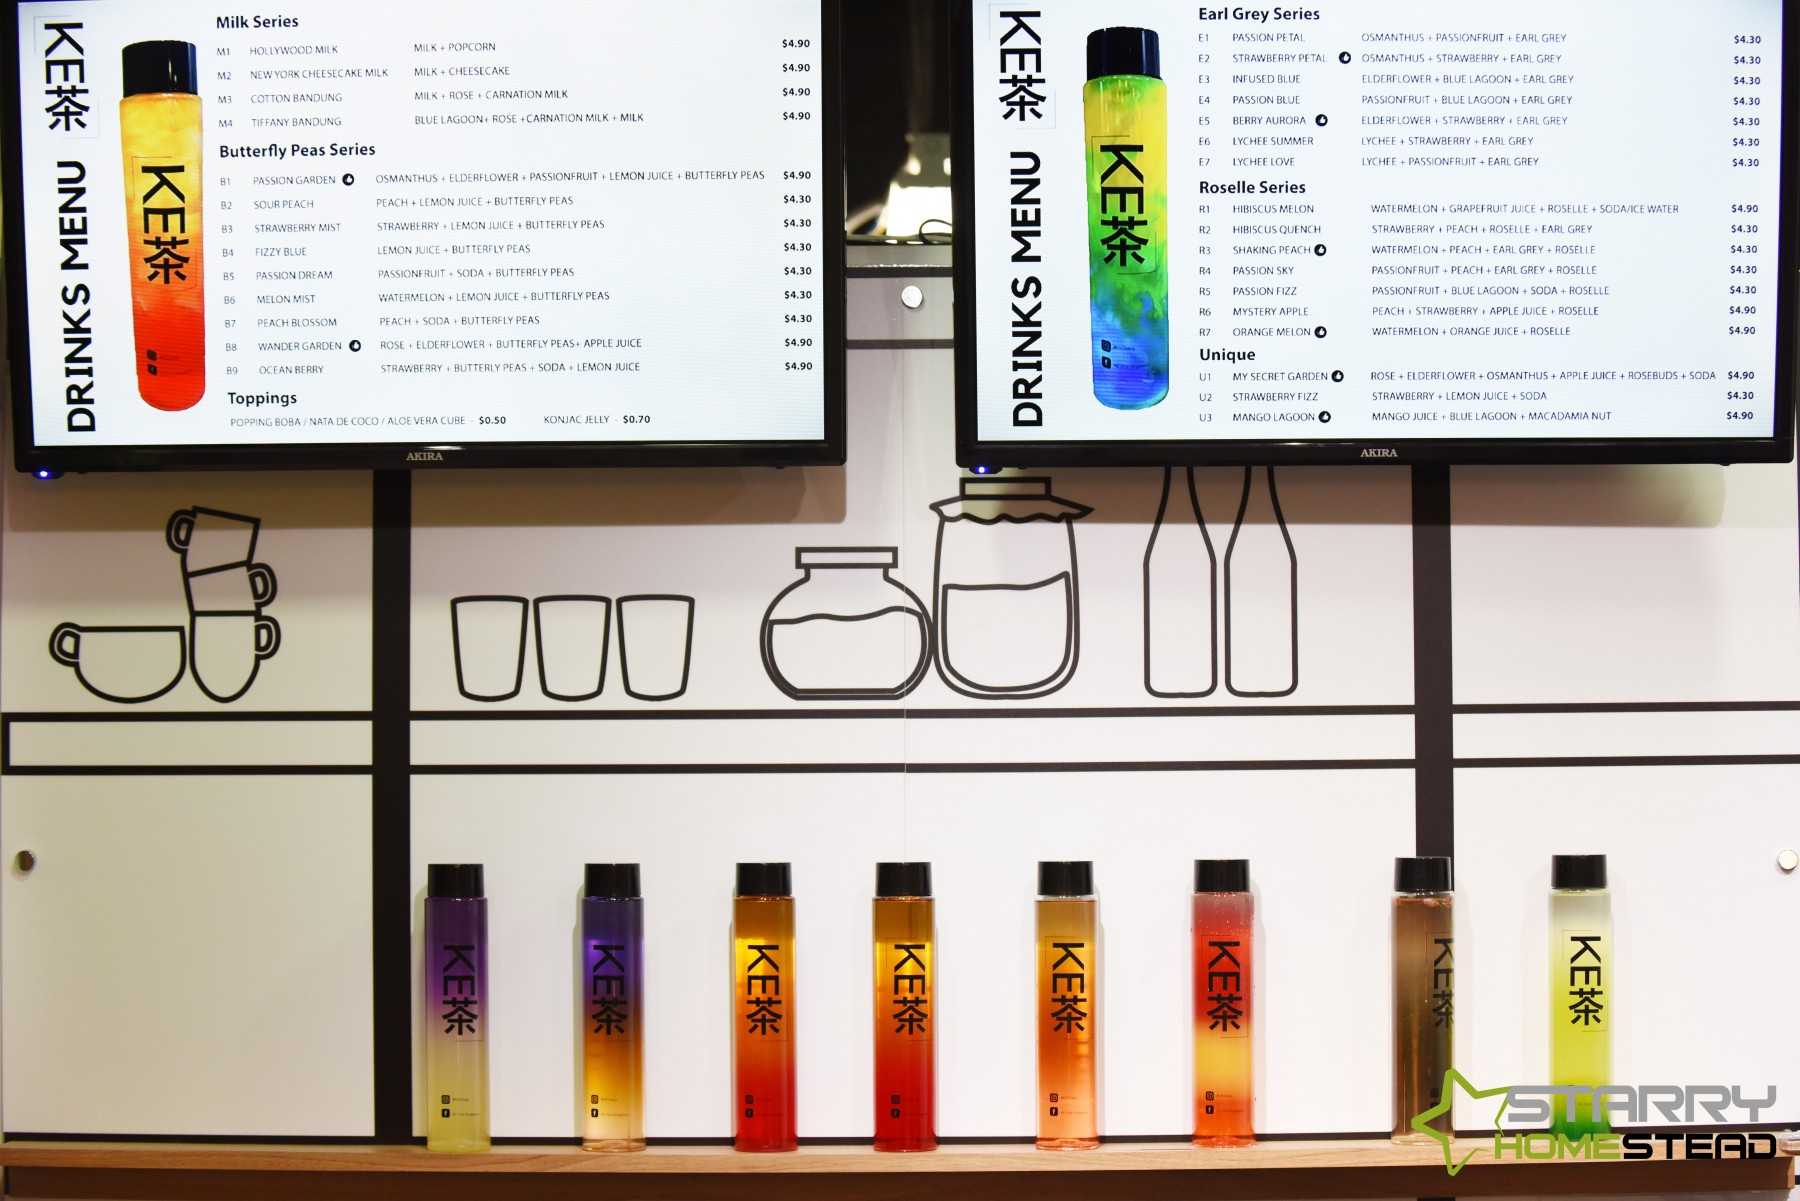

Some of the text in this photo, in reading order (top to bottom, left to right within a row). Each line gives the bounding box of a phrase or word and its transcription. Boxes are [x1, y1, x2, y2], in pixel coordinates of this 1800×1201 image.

[1198, 7, 1320, 23] Earl Grey Series
[216, 14, 298, 28] Milk Series
[1232, 32, 1302, 42] PASSION PETAL
[1361, 32, 1424, 42] OSMANTHUS
[1734, 35, 1761, 44] $4.30
[448, 42, 495, 51] POPCORN
[782, 39, 810, 48] $4.90
[249, 45, 338, 55] HOLLYWOOD MILK
[1232, 53, 1324, 62] STRAWBERRY PETAL
[1733, 55, 1761, 64] $4.30
[782, 63, 810, 72] $4.90
[999, 11, 1047, 121] KE茶
[250, 68, 388, 79] NEW YORK CHEESECAKE MILK
[448, 66, 509, 76] CHEESECAKE
[44, 22, 90, 131] KE茶
[1232, 74, 1300, 83] INFUSED BLUE
[1469, 74, 1511, 83] LAGOON
[1733, 76, 1760, 85] $4.30
[782, 87, 810, 96] $4.90
[250, 93, 342, 103] COTTON BANDUNG
[1232, 95, 1300, 104] PASSION BLUE
[1733, 96, 1760, 105] $4.30
[782, 111, 810, 120] $4.90
[1442, 115, 1505, 125] STRAWBERRY
[251, 117, 341, 127] TIFFANY BANDUNG
[1232, 116, 1306, 125] BERRY AURORA
[1732, 117, 1760, 126] $4.30
[1232, 136, 1313, 145] LYCHEE SUMMER
[1732, 137, 1759, 146] $4.30
[219, 142, 375, 159] Butterfly Peas Series
[1232, 157, 1294, 166] LYCHEE LOVE
[1732, 158, 1759, 167] $4.30
[449, 172, 518, 182] ELDERFLOWER
[783, 170, 811, 180] $4.90
[253, 175, 335, 185] PASSION GARDEN
[1199, 181, 1306, 194] Roselle Series
[783, 194, 811, 204] $4.30
[253, 199, 313, 209] SOUR PEACH
[1100, 144, 1149, 267] KE茶
[1232, 204, 1314, 213] HIBISCUS MELON
[1448, 204, 1507, 213] GRAPEFRUIT
[1731, 204, 1758, 212] $4.90
[141, 165, 190, 284] KE茶
[783, 218, 811, 227] $4.30
[254, 223, 339, 232] STRAWBERRY MIST
[1232, 225, 1321, 234] HIBISCUS QUENCH
[1731, 224, 1758, 233] $4.30
[783, 242, 811, 251] $4.30
[1232, 245, 1310, 254] SHAKING PEACH
[1730, 245, 1757, 253] $4.30
[255, 247, 306, 256] FIZZY BLUE
[378, 268, 445, 278] PASSIONFRUIT
[784, 266, 811, 275] $4.30
[1232, 266, 1294, 275] PASSION SKY
[1730, 265, 1757, 274] $4.30
[256, 270, 332, 280] PASSION DREAM
[1010, 151, 1043, 426] DRINKS MENU
[1232, 286, 1296, 296] PASSION FIZZ
[1729, 285, 1756, 294] $4.30
[57, 161, 96, 432] DRINKS MENU
[256, 294, 314, 304] MELON MIST
[378, 292, 444, 302] WATERMELON
[784, 290, 812, 299] $4.30
[1232, 307, 1308, 316] MYSTERY APPLE
[1729, 305, 1756, 314] $4.90
[257, 318, 336, 327] PEACH BLOSSOM
[784, 314, 812, 323] $4.30
[1232, 327, 1310, 336] ORANGE MELON
[1449, 326, 1490, 335] ORANGE
[1728, 326, 1755, 335] $4.90
[257, 341, 341, 351] WANDER GARDEN
[784, 338, 812, 346] $4.90
[1200, 348, 1255, 363] Unique
[258, 365, 323, 374] OCEAN BERRY
[453, 363, 500, 372] BUTTERLY
[784, 361, 812, 370] $4.90
[1232, 371, 1328, 381] MY SECRET GARDEN
[1627, 370, 1678, 380] ROSEBUDS
[1727, 371, 1754, 379] $4.90
[228, 392, 297, 407] Toppings
[1232, 392, 1318, 401] STRAWBERRY FIZZ
[1727, 391, 1754, 399] $4.30
[543, 415, 650, 424] KONJAC JELLY $0.70
[1232, 412, 1314, 422] MANGO LAGOON
[1528, 411, 1588, 420] MACADAMIA
[1726, 411, 1753, 420] $4.90
[230, 416, 506, 426] POPPING BOBA NATA DE COCO ALOE VERA CUBE $0.50
[406, 452, 444, 461] AKIRA
[1360, 448, 1399, 458] AKIRA
[1568, 936, 1604, 1026] KE茶
[442, 944, 479, 1036] KE茶
[592, 944, 628, 1036] KE茶
[746, 944, 783, 1036] KE茶
[893, 944, 929, 1035] KE茶
[1051, 942, 1088, 1033] KE茶
[1207, 941, 1243, 1032] KE茶
